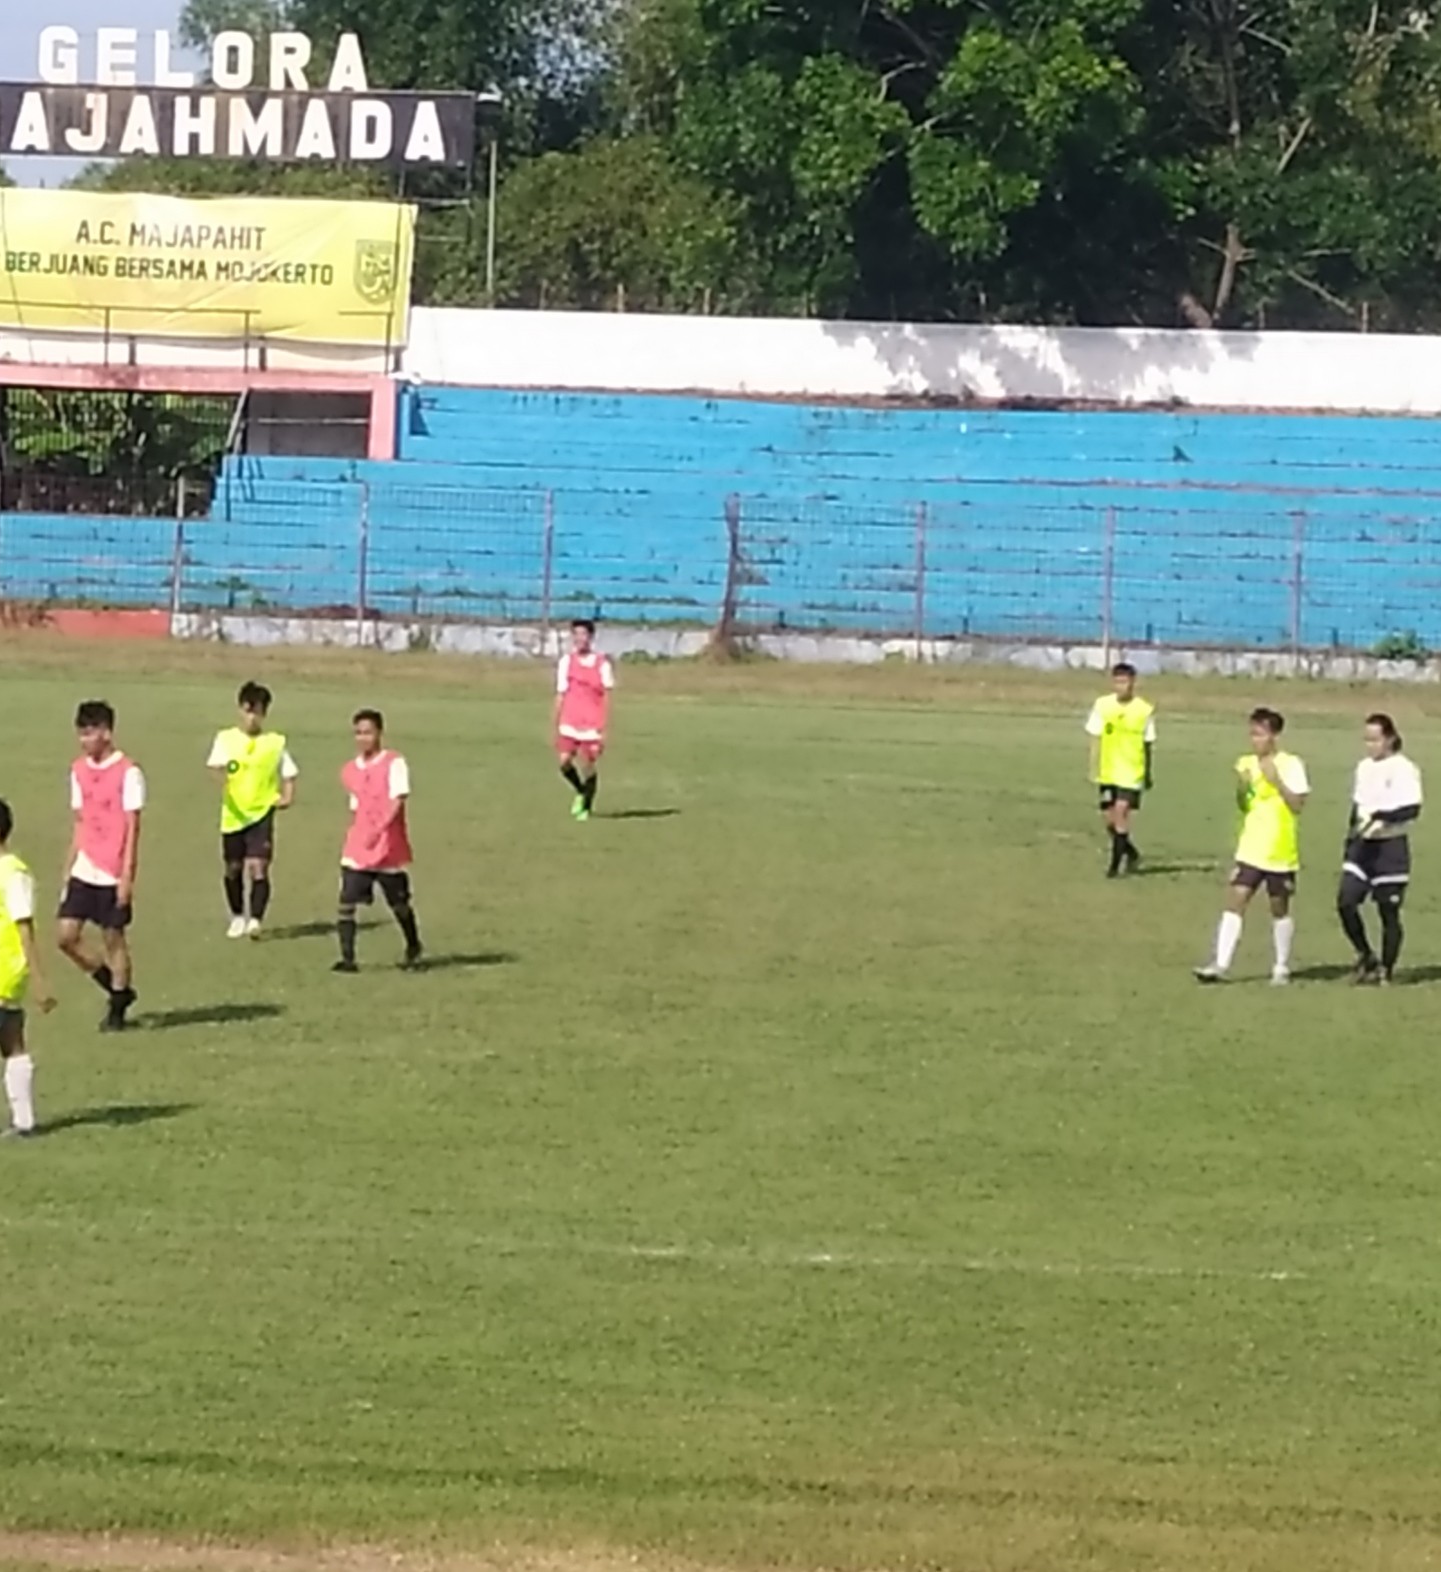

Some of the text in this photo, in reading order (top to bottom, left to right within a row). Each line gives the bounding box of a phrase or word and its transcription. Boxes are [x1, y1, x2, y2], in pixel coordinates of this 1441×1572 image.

[38, 26, 369, 92] GELORA
[75, 219, 267, 251] A.C. MAJAPAHIT
[4, 250, 334, 286] BERJUANG BERSAMA MOJOKERTO
